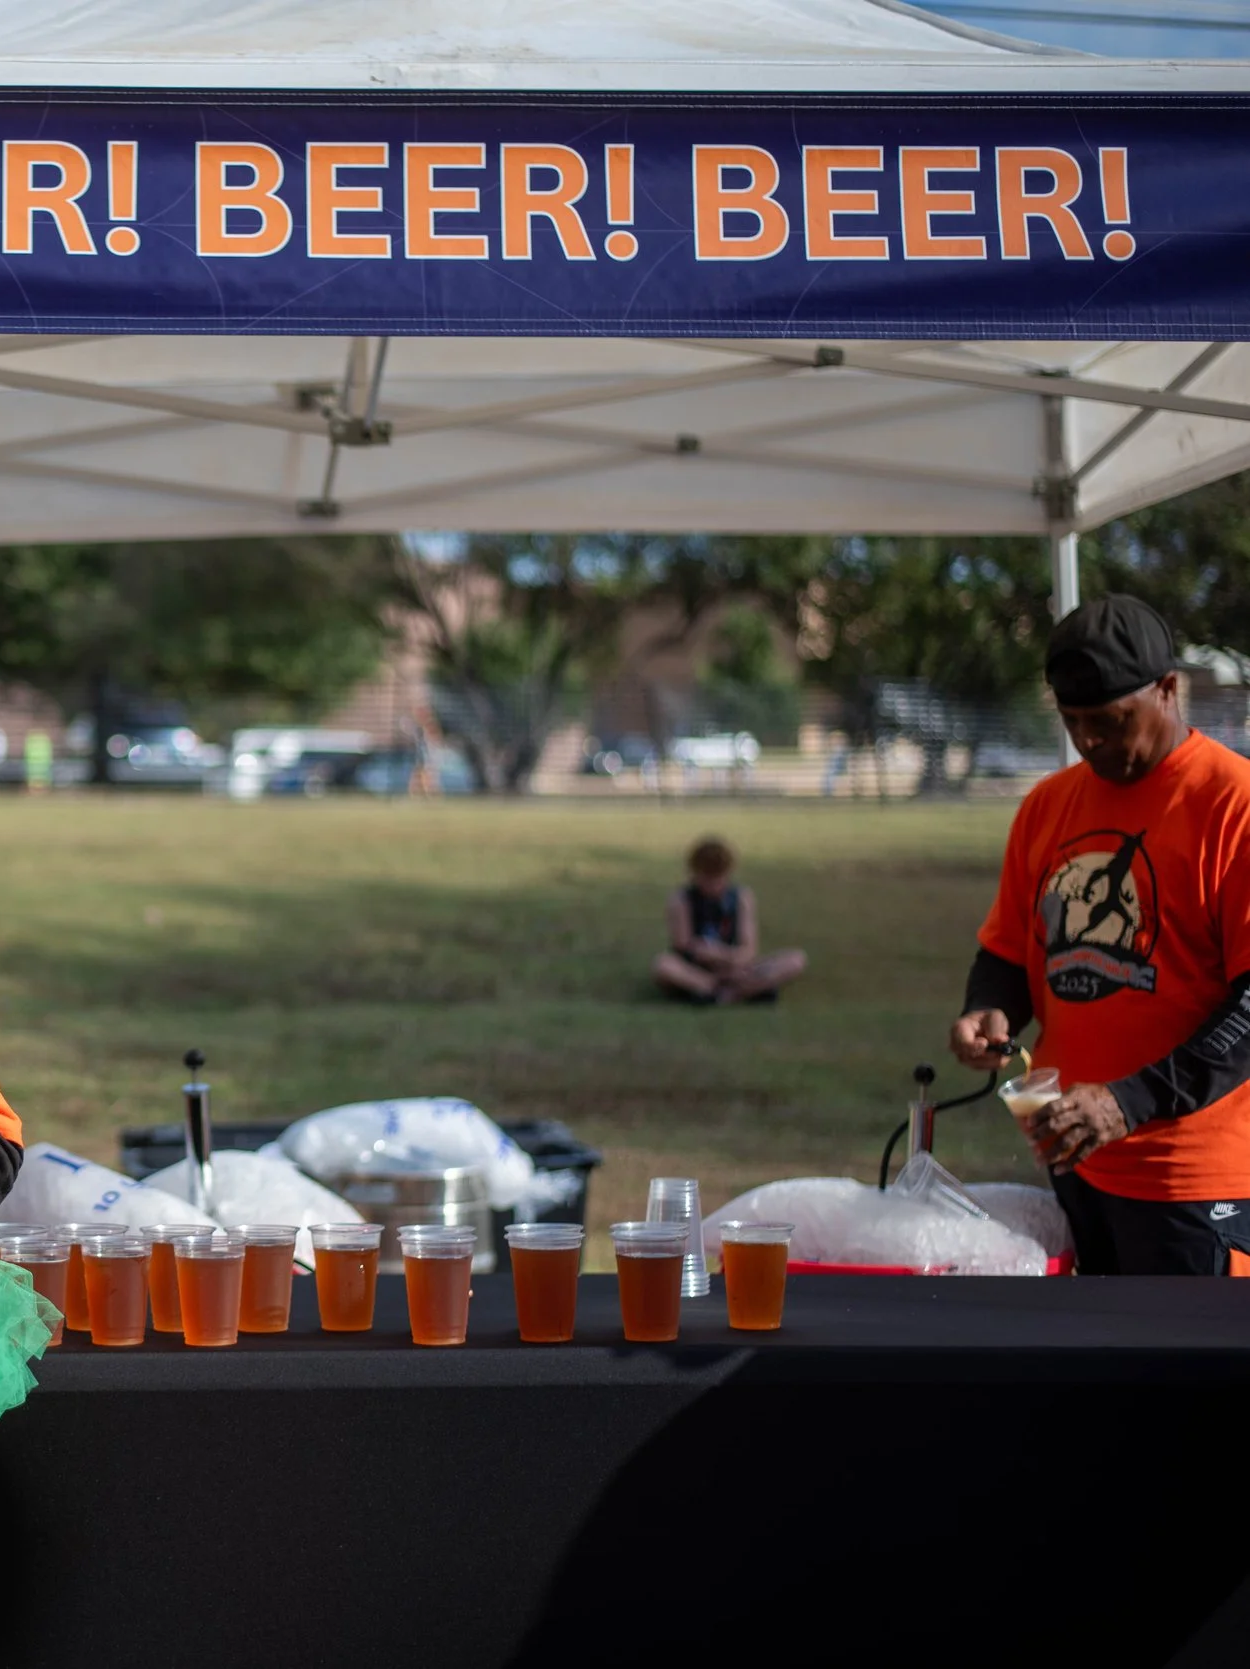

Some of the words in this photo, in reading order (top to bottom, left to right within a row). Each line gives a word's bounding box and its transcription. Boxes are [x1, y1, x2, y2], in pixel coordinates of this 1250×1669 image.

[196, 141, 639, 261] BEER!
[692, 144, 1136, 261] BEER!
[1214, 1202, 1237, 1213] NIKE
